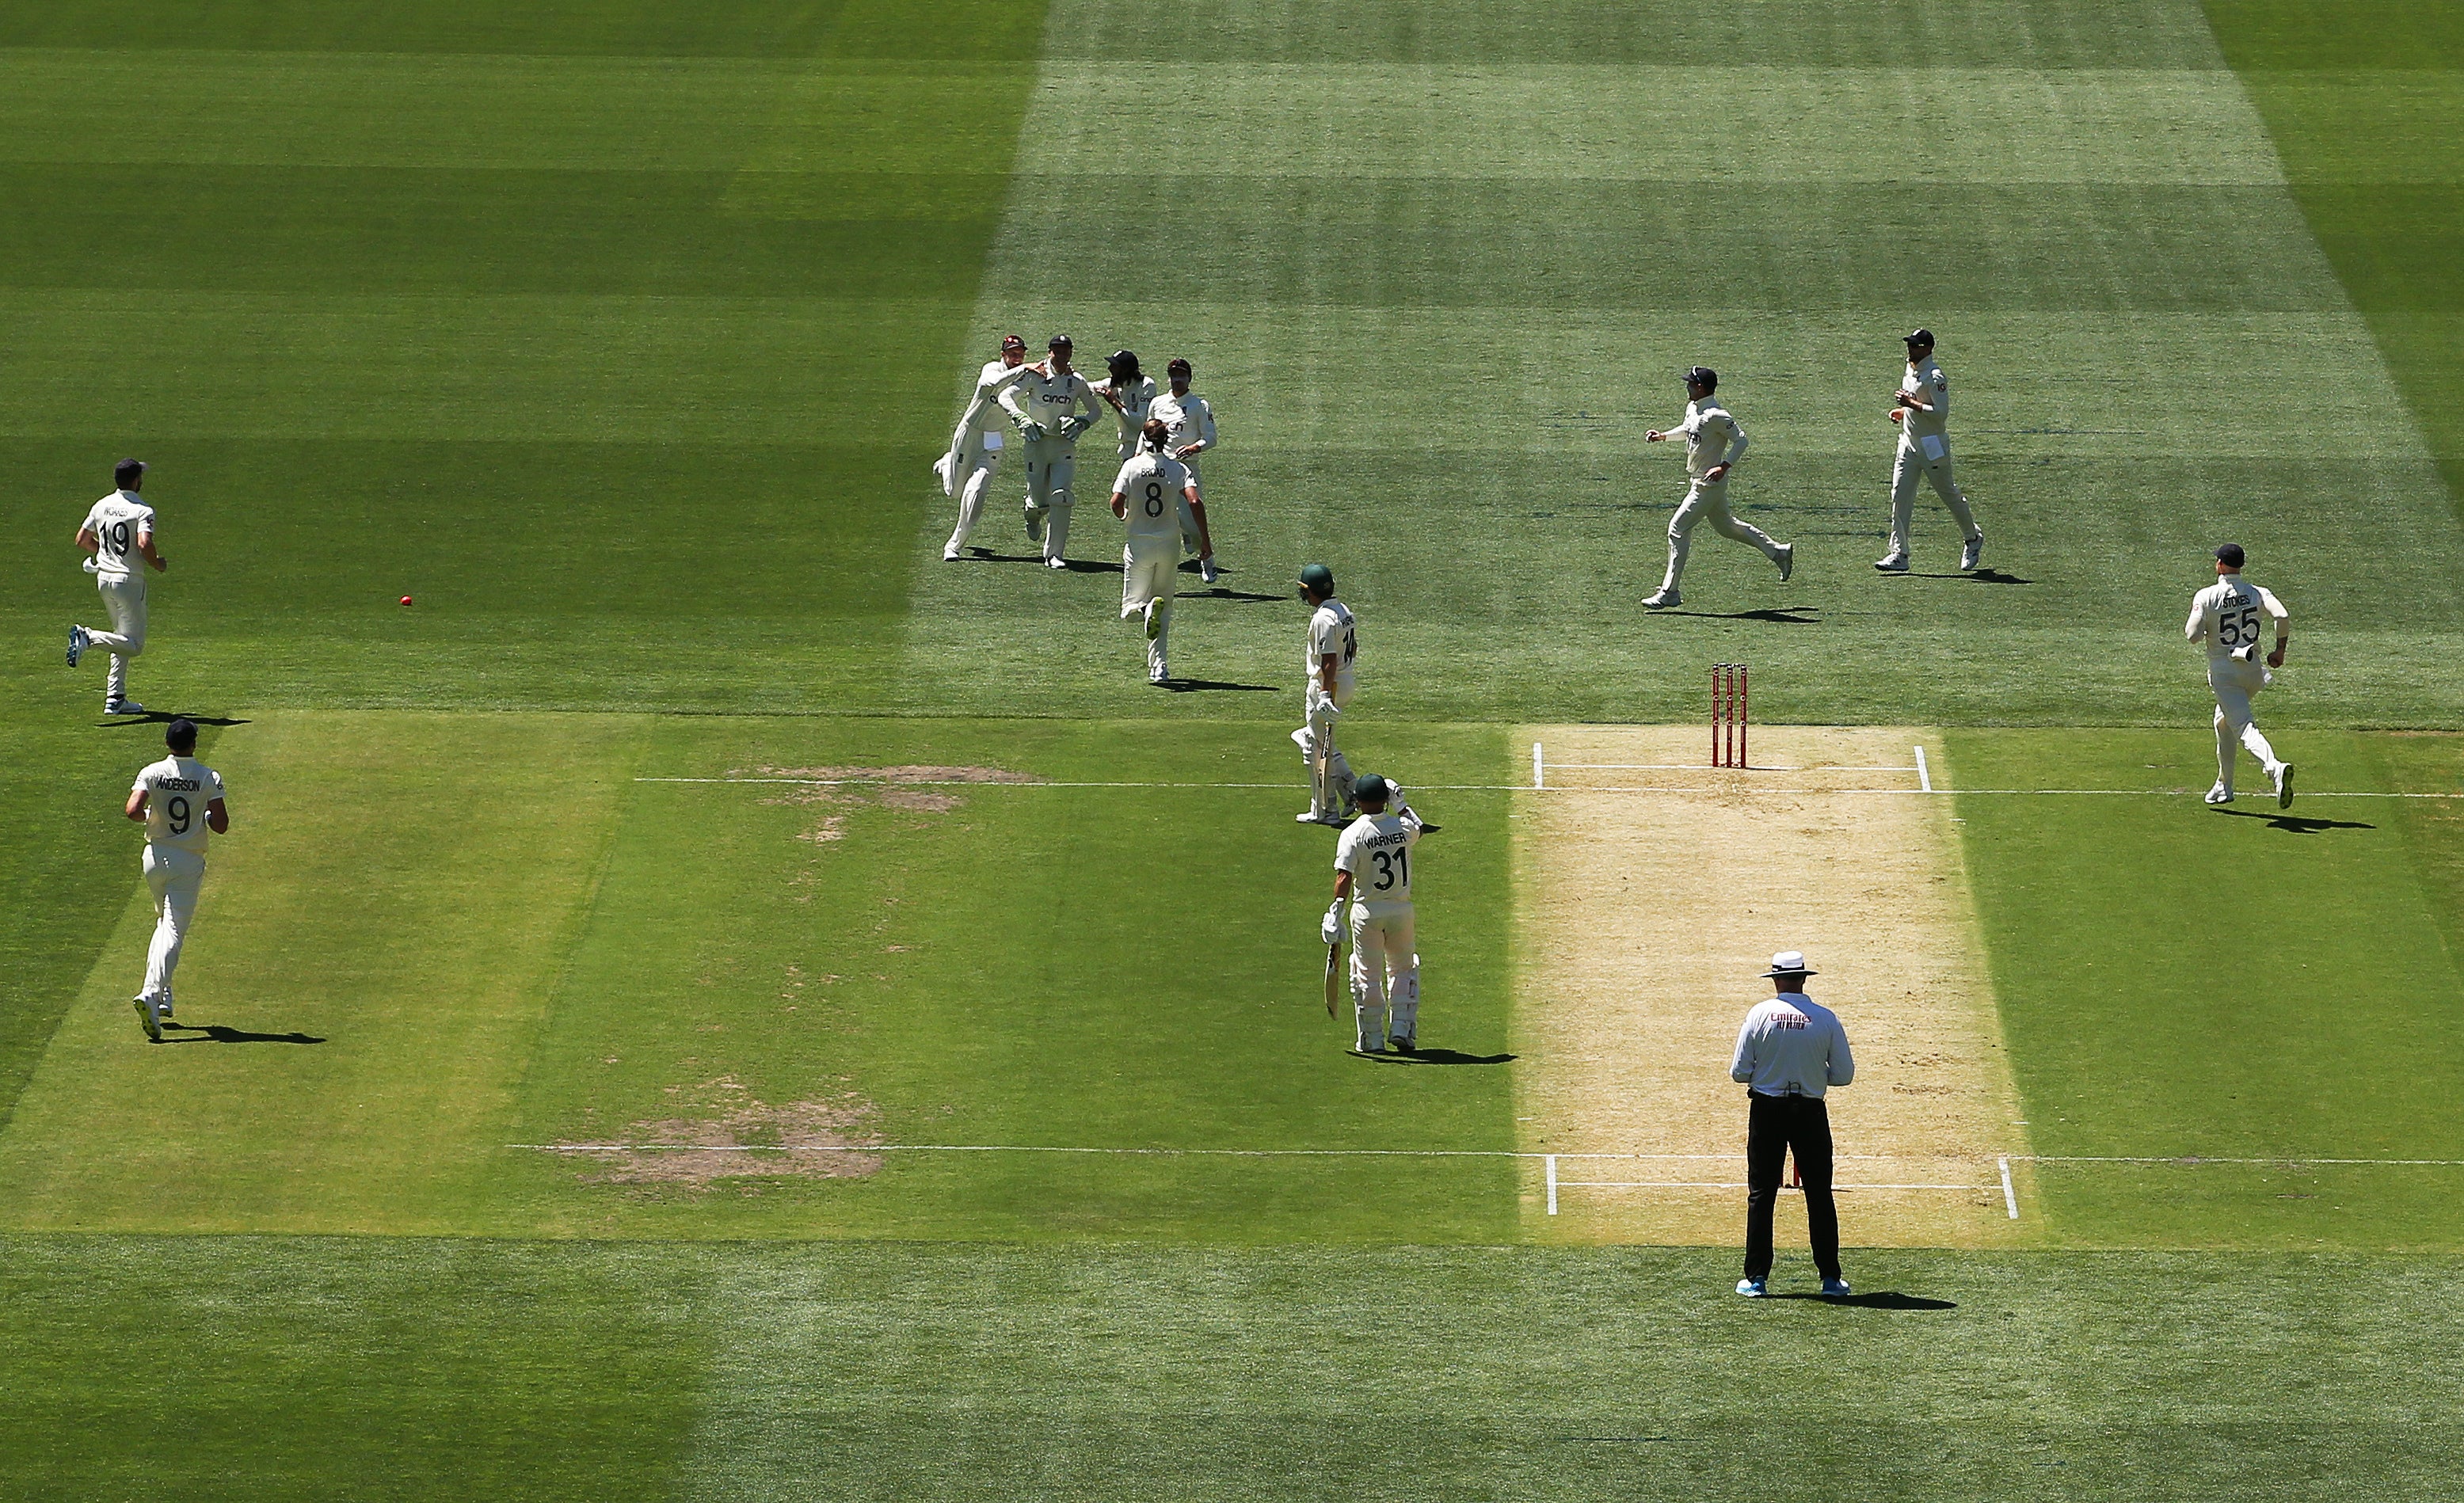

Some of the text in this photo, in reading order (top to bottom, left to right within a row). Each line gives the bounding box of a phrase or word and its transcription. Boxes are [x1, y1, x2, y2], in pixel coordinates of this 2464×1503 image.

[1042, 394, 1072, 405] cinch
[1141, 468, 1166, 478] BROAD
[1144, 482, 1163, 518] 8
[100, 520, 130, 556] 19
[2223, 595, 2250, 608] STOKES
[2220, 607, 2260, 645] 55
[156, 774, 200, 792] ANDERSON
[168, 796, 190, 835] 9
[1365, 831, 1407, 850] WARNER
[1372, 846, 1407, 890] 31
[1770, 1012, 1811, 1022] Emirates
